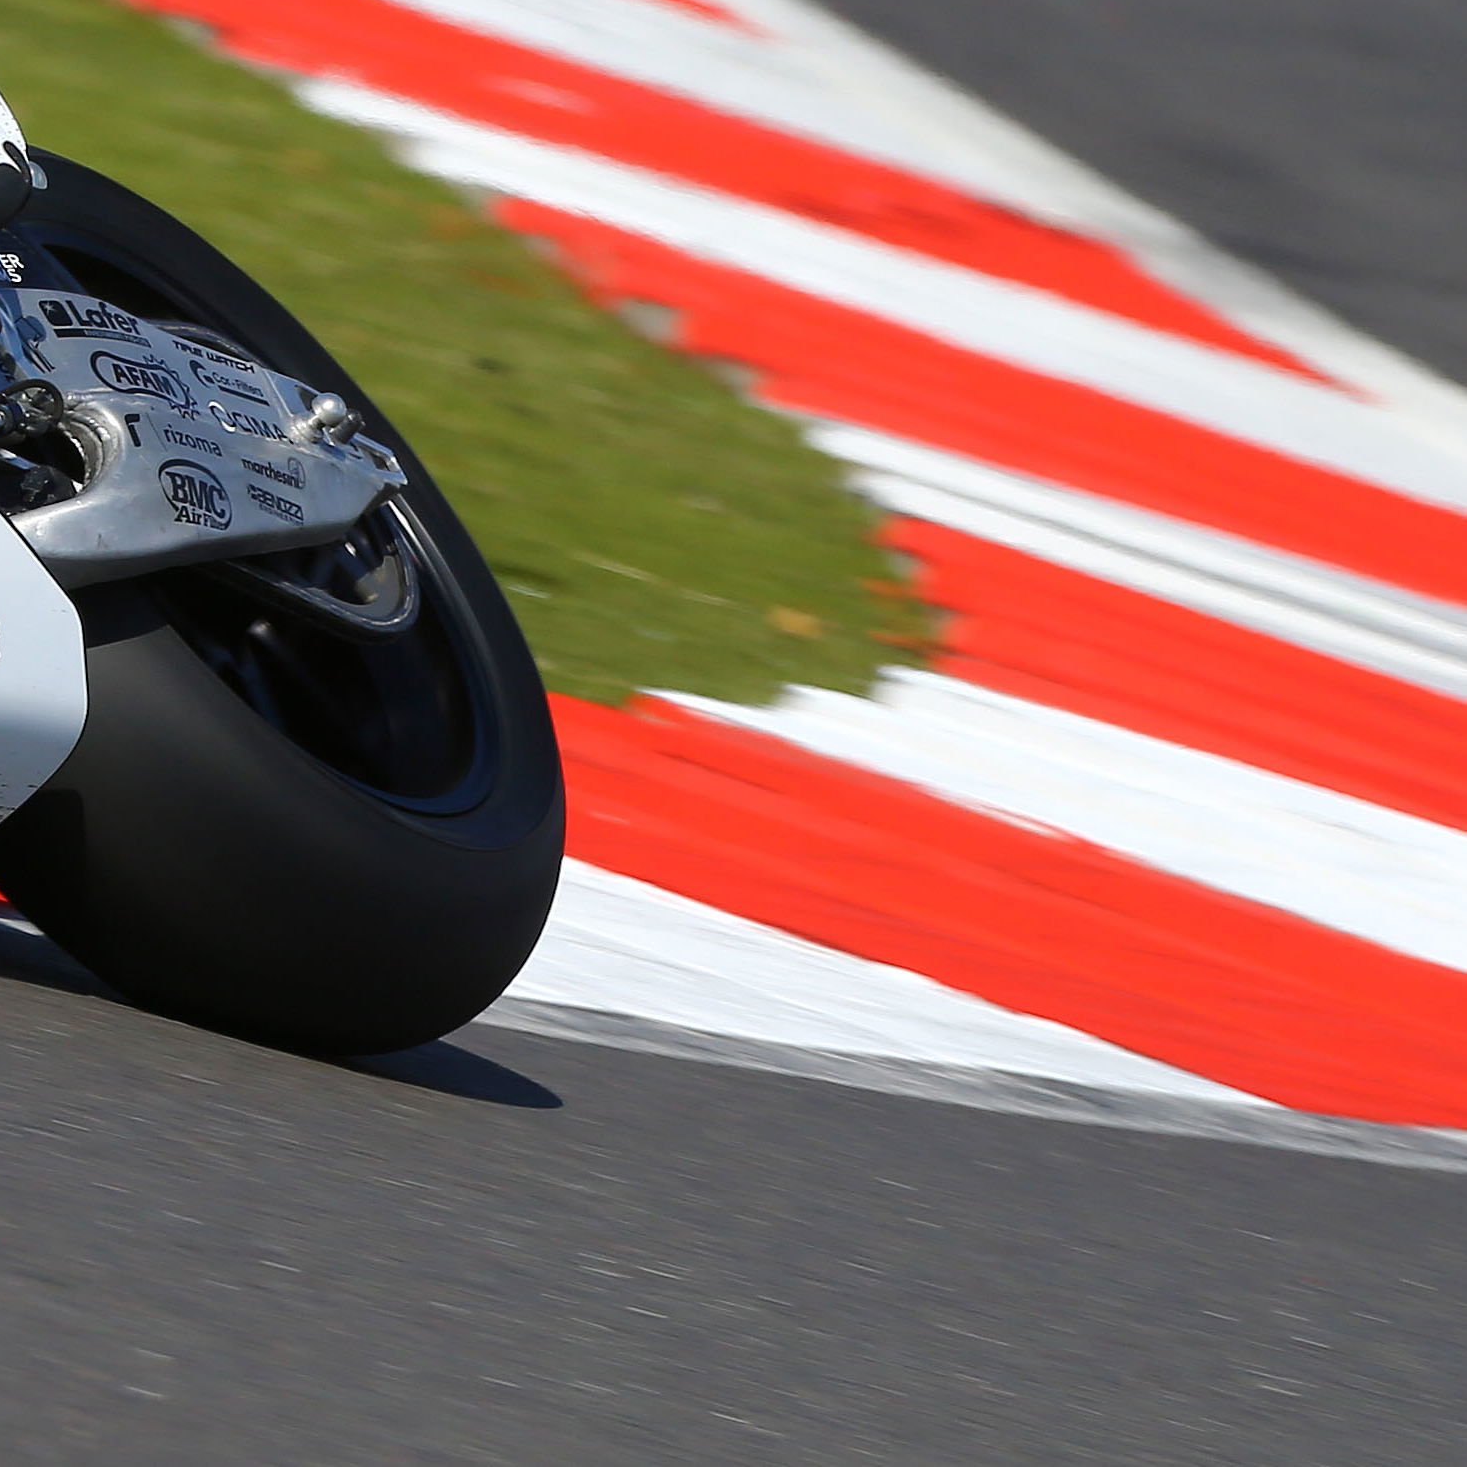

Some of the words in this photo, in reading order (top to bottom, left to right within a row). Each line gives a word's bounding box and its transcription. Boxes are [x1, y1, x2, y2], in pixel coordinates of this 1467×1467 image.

[65, 300, 142, 335] Lafer
[111, 363, 180, 399] AFAM
[163, 423, 223, 457] rizoma
[164, 471, 227, 519] BMC
[174, 505, 203, 525] Air
